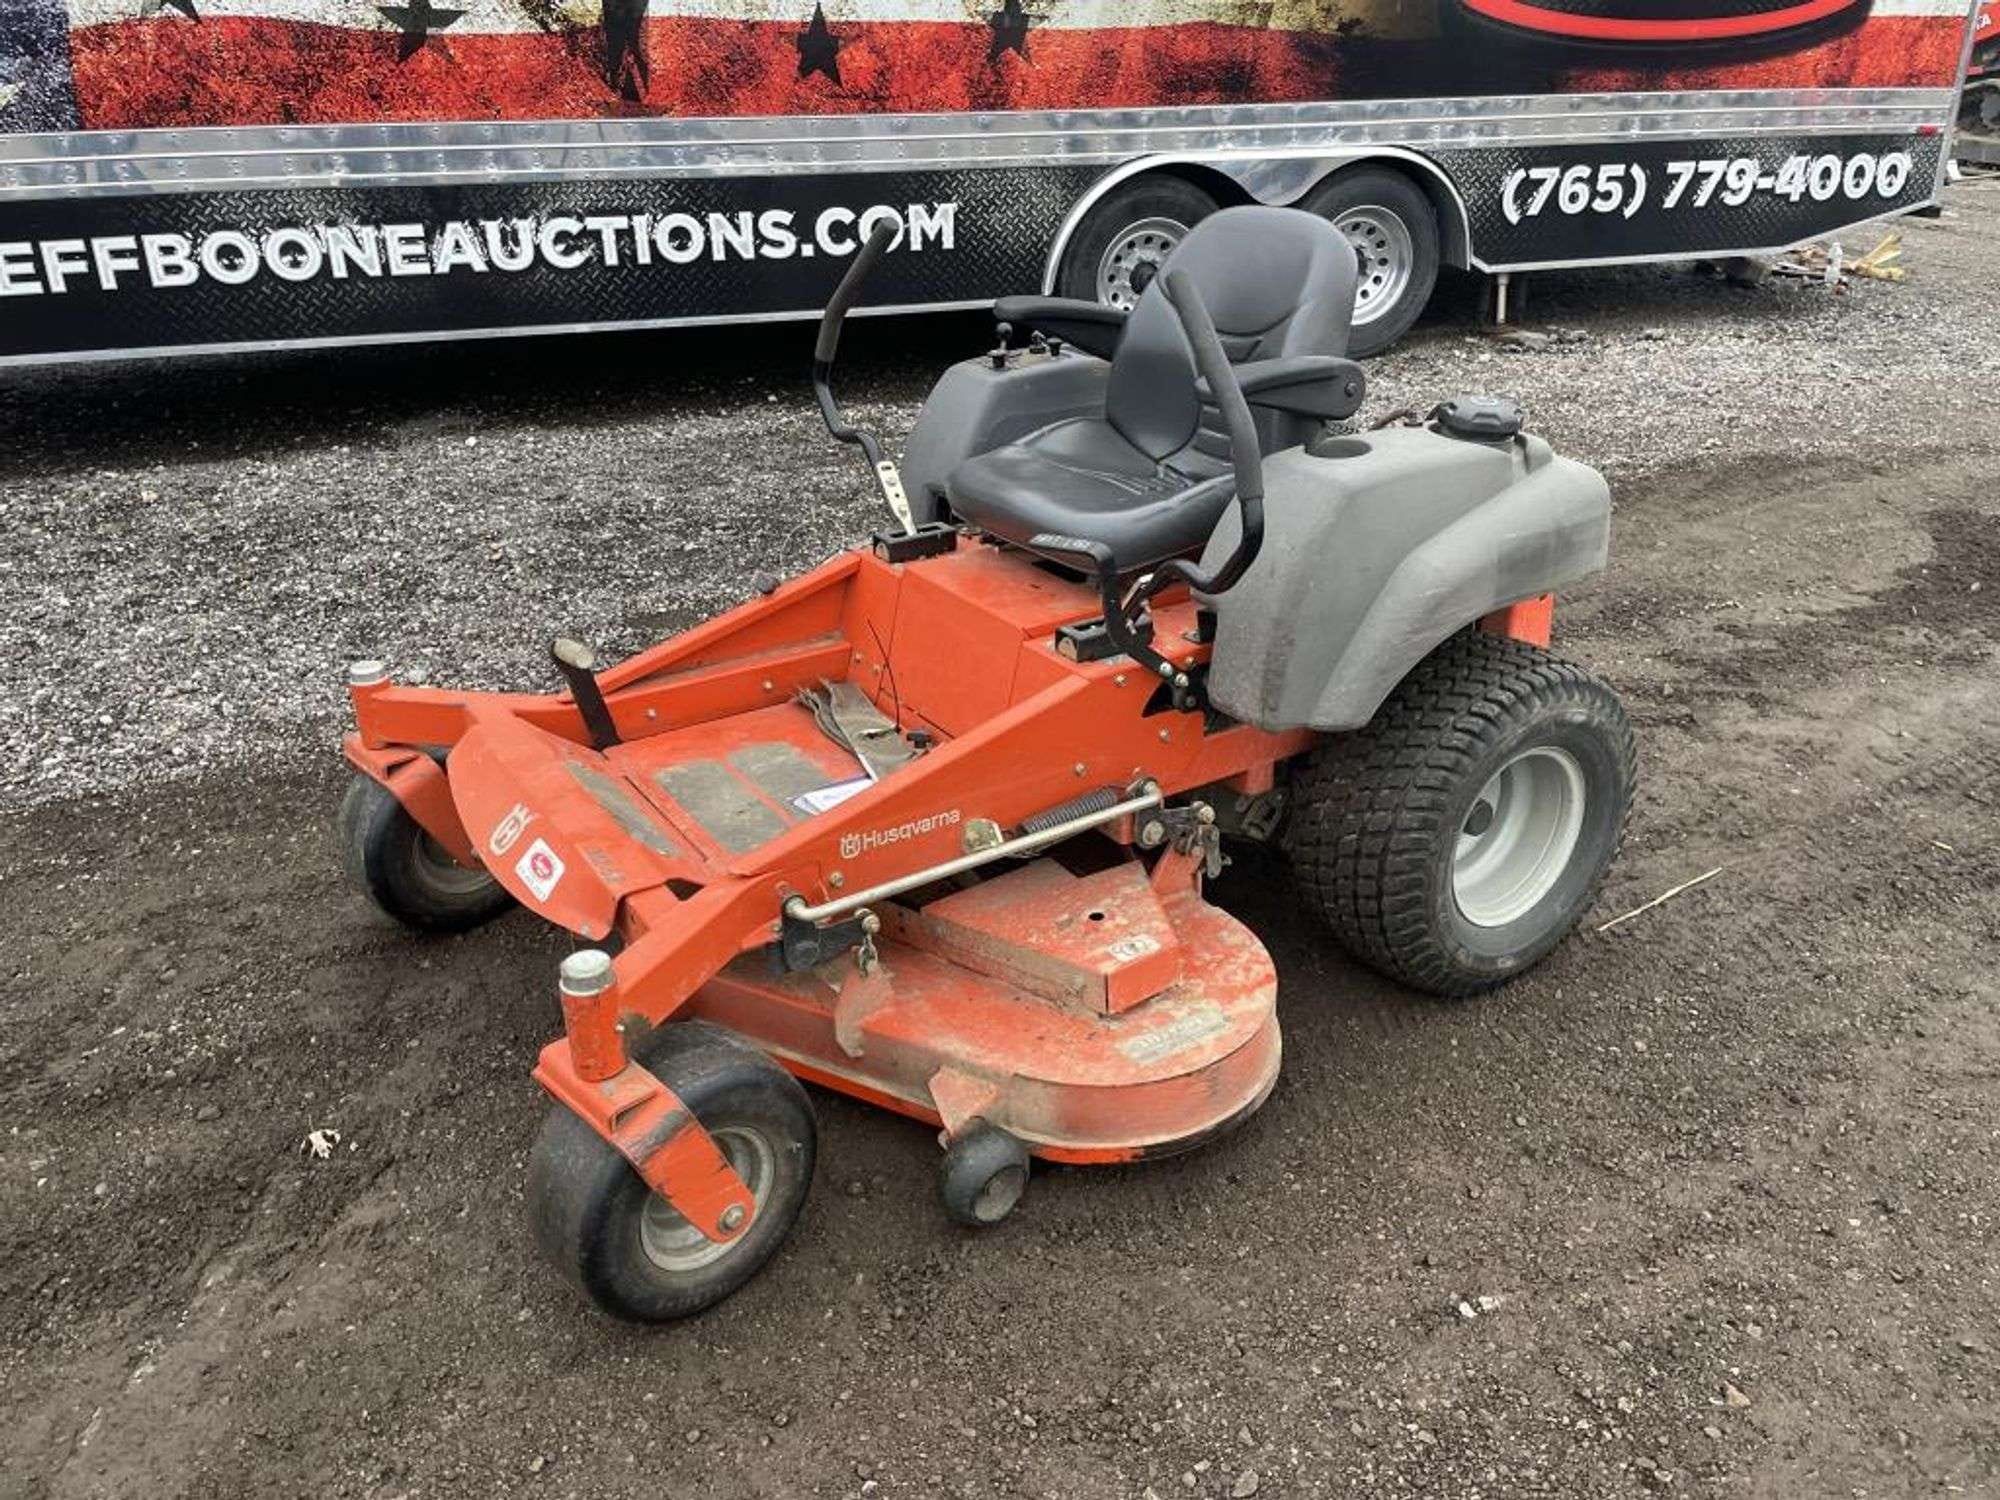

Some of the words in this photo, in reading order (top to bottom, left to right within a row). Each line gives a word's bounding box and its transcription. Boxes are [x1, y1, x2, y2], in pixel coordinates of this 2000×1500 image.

[1502, 163, 1646, 226] (765)
[1662, 152, 1910, 208] 779-4000
[862, 809, 961, 849] Husqvarna
